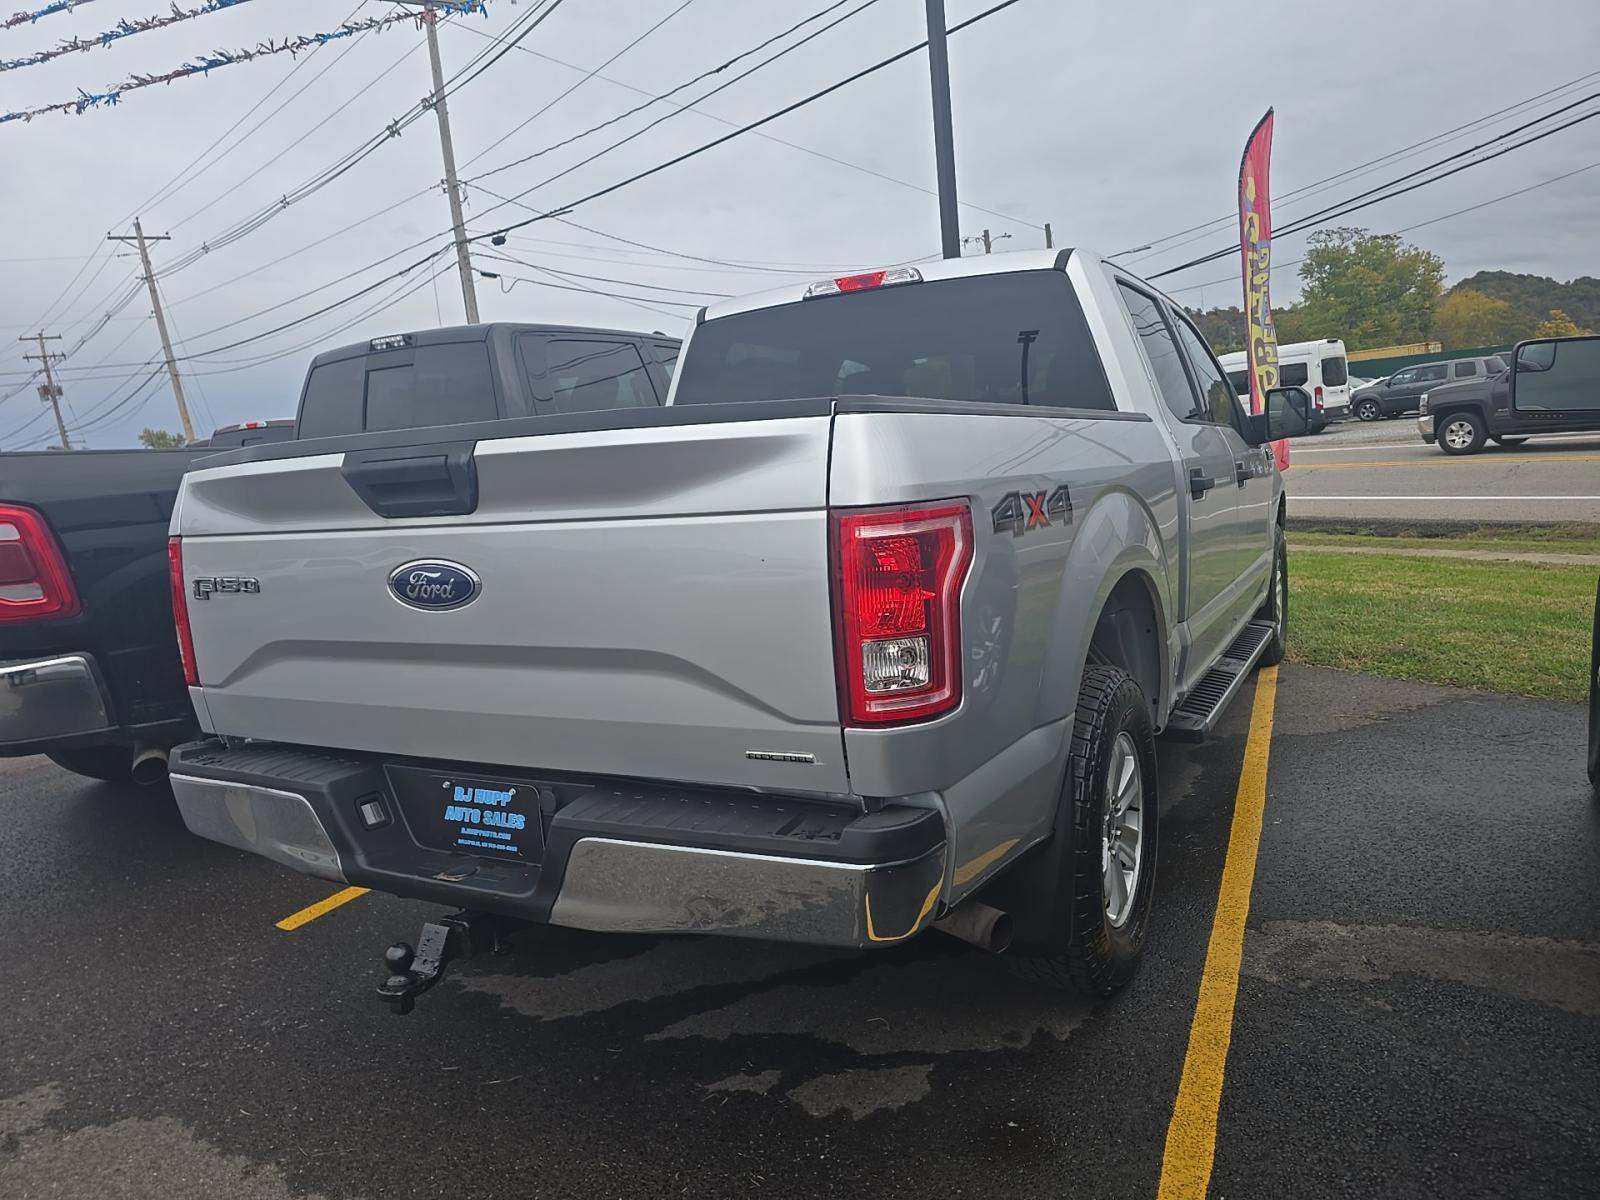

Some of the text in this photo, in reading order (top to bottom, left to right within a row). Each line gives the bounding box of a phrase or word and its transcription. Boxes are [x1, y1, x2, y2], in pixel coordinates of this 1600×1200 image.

[406, 570, 456, 599] Ford
[454, 786, 511, 806] BJ HUPP
[445, 805, 525, 829] AUTO SALES
